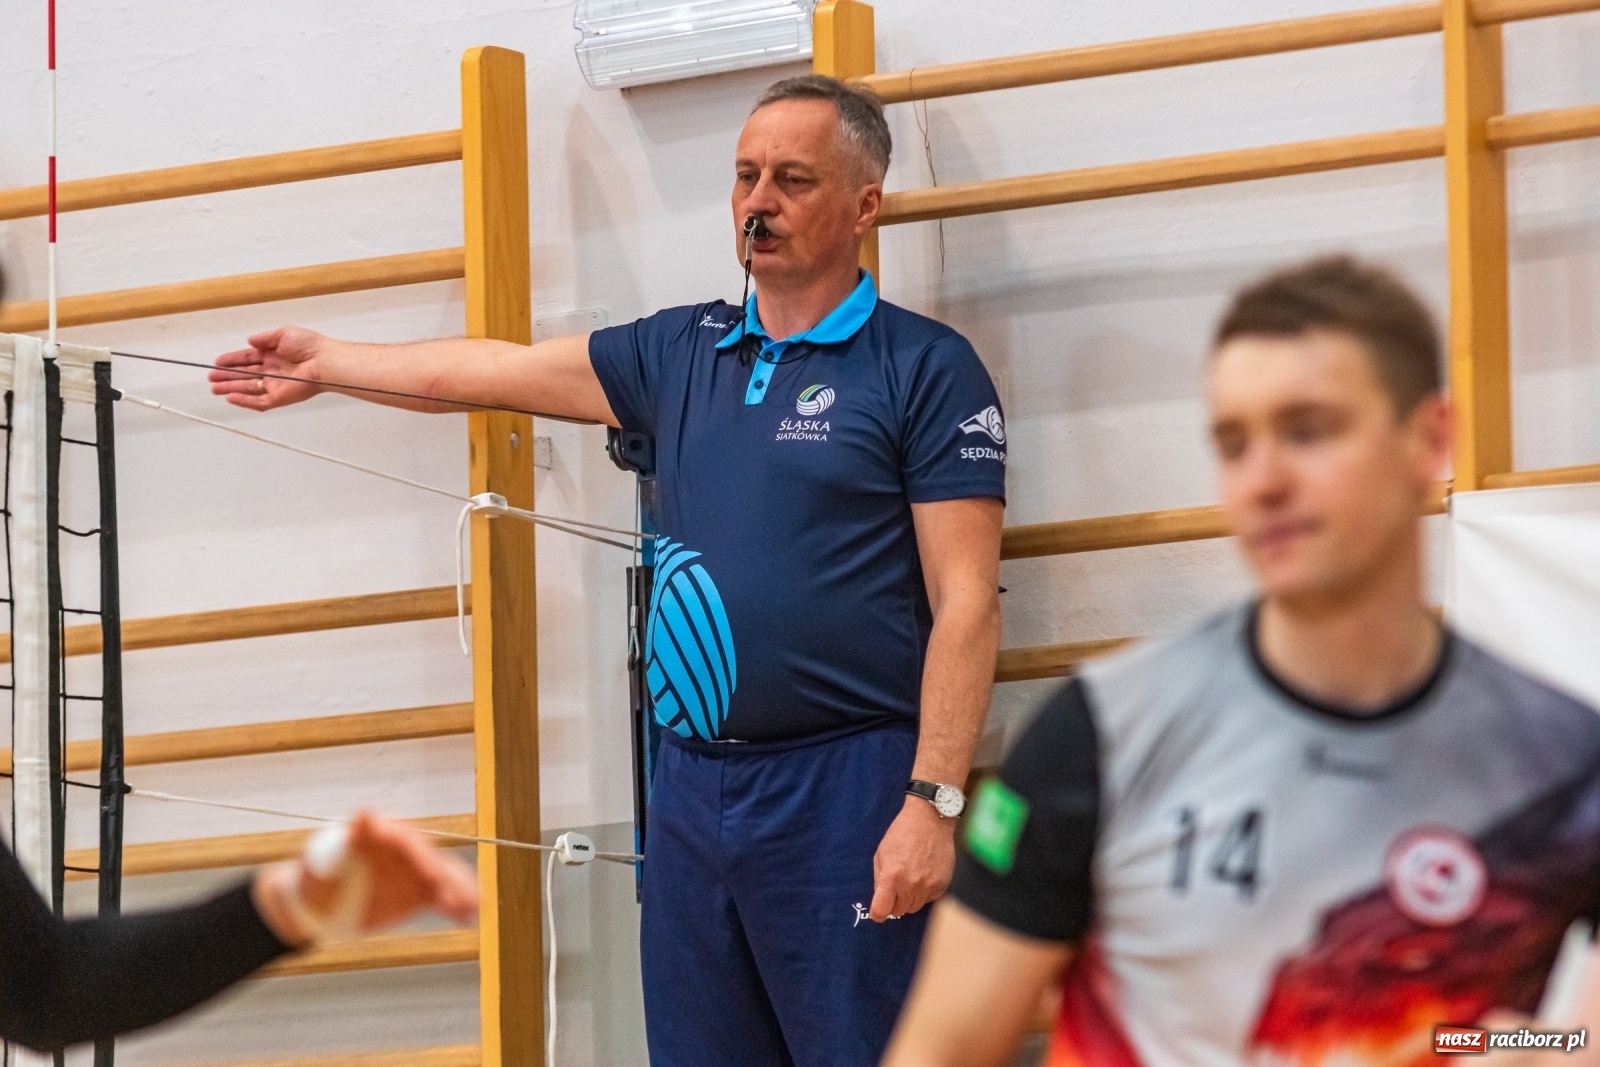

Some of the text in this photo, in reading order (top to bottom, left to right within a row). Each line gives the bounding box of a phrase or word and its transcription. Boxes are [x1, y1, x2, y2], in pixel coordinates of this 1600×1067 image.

[779, 417, 830, 432] ŚLĄSKA
[775, 431, 828, 442] SIATKÓWKA
[960, 447, 999, 461] SĘDZIA
[1169, 807, 1262, 903] 14
